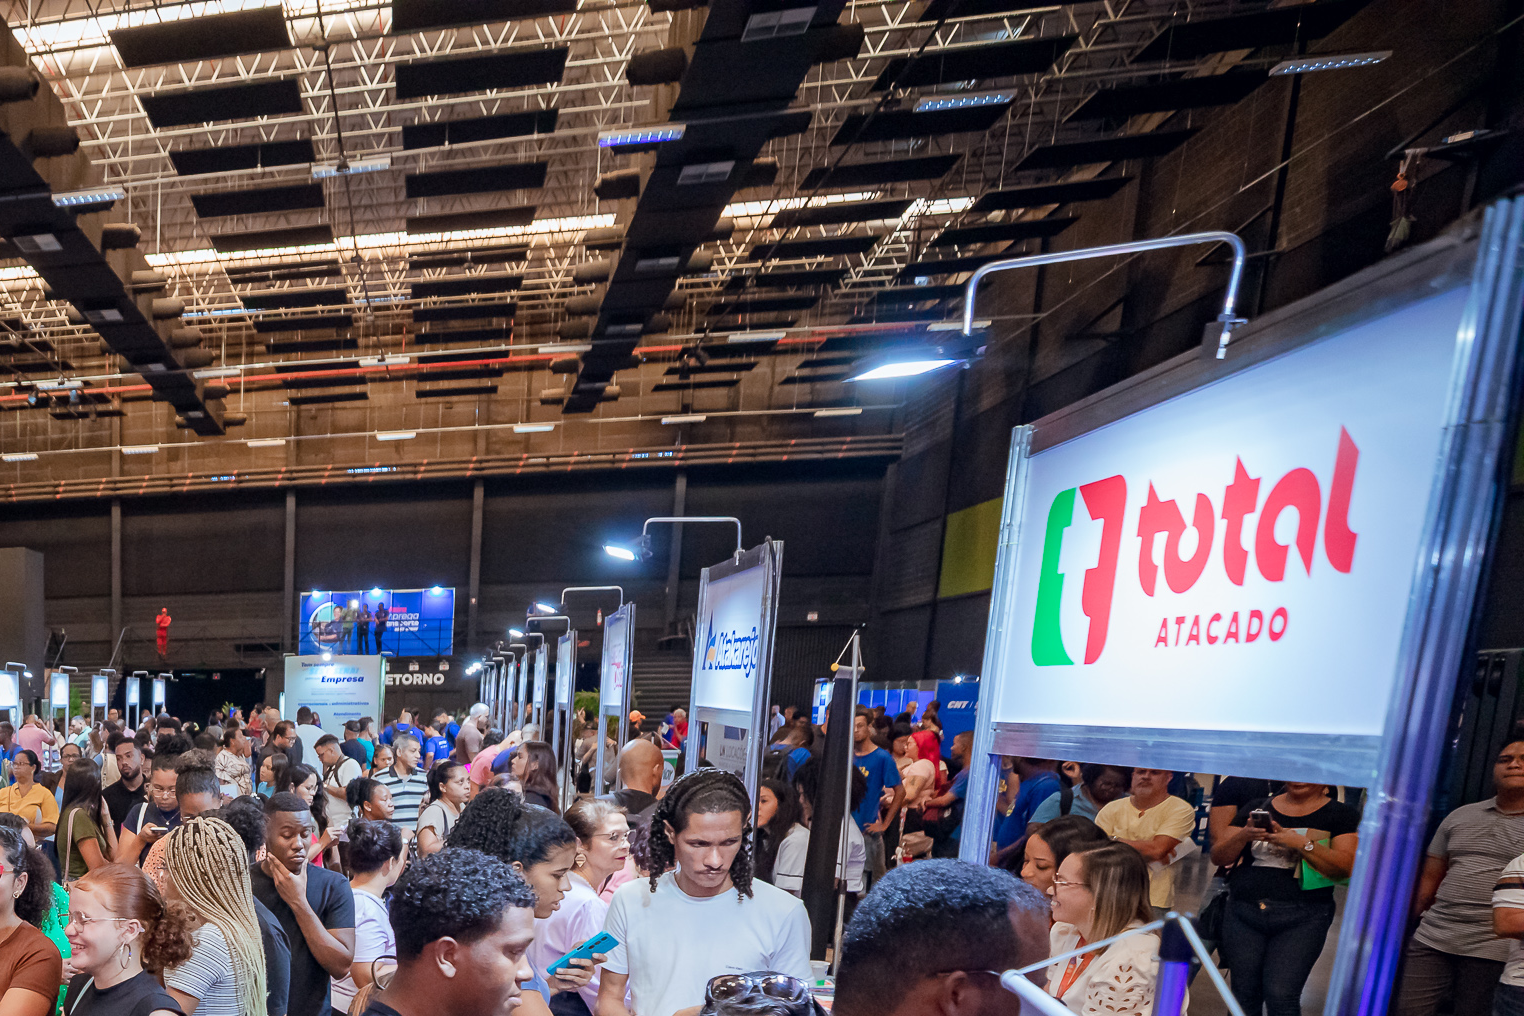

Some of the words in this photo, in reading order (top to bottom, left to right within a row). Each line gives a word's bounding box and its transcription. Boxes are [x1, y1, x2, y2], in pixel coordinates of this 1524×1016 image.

[1137, 423, 1360, 597] total
[1155, 607, 1289, 649] ATACADO
[321, 676, 365, 685] Empresa
[385, 673, 445, 686] ETORNO
